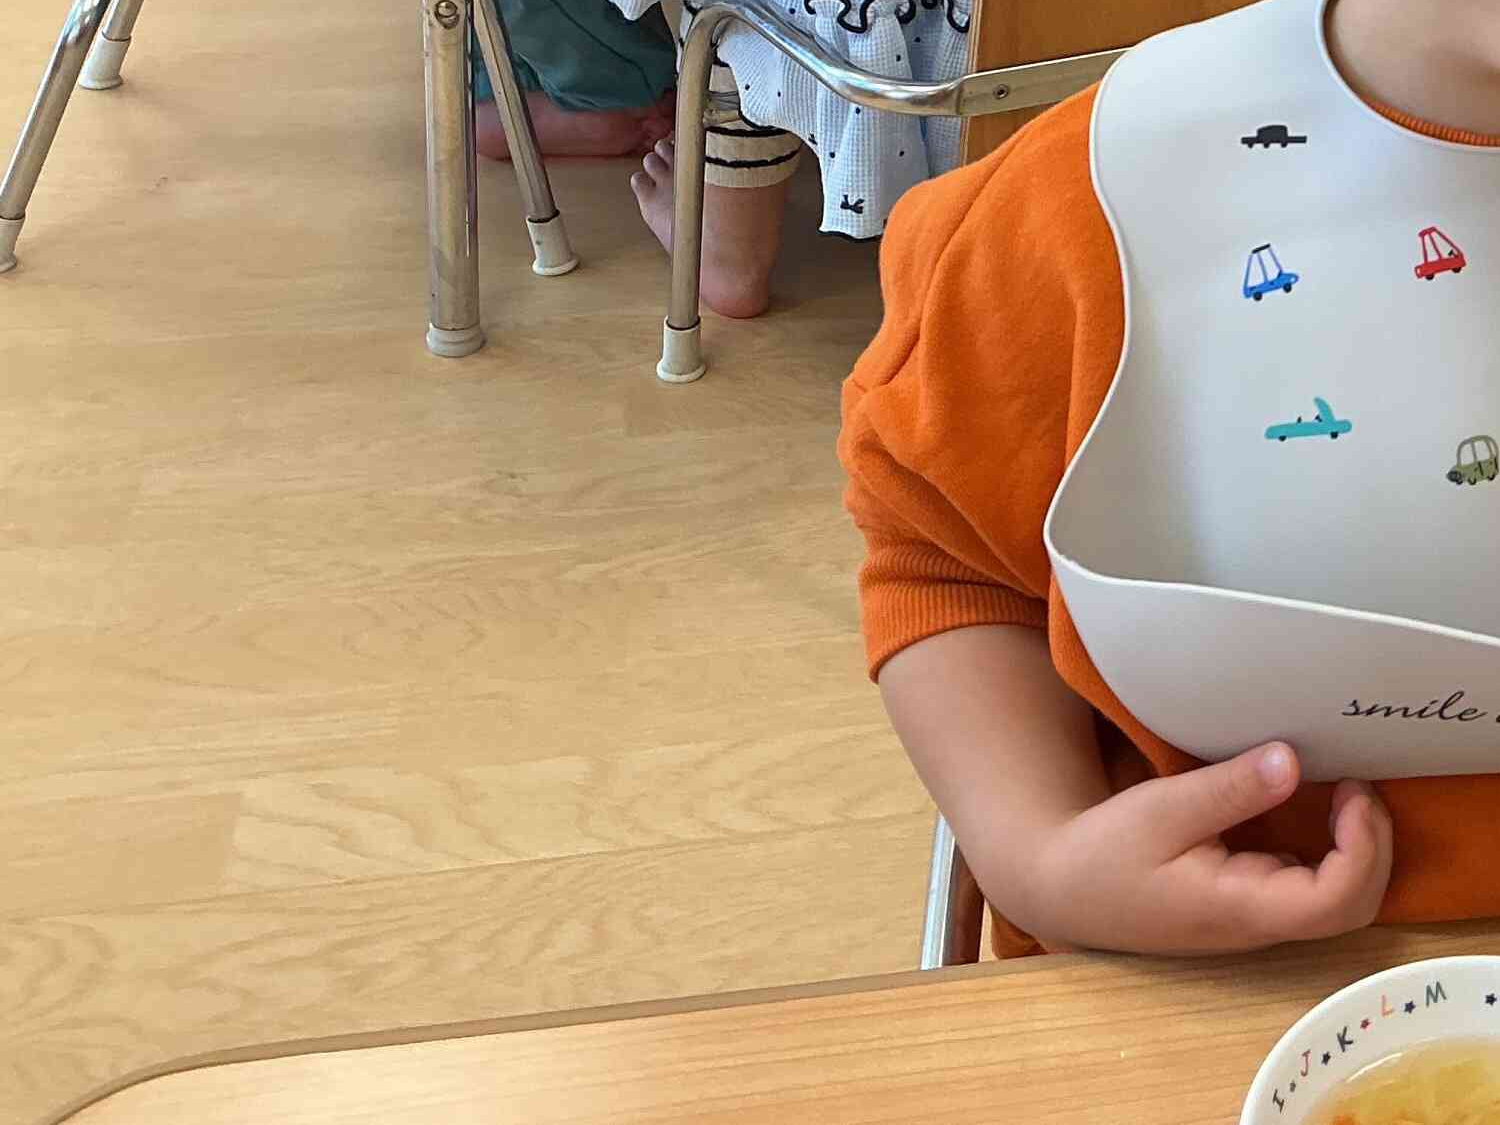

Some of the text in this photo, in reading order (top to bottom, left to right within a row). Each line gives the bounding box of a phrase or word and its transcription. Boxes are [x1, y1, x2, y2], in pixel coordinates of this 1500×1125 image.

[1341, 690, 1488, 722] smile
[1300, 1048, 1312, 1078] J
[1336, 1026, 1354, 1054] K
[1380, 994, 1395, 1018] L
[1425, 981, 1448, 1008] M
